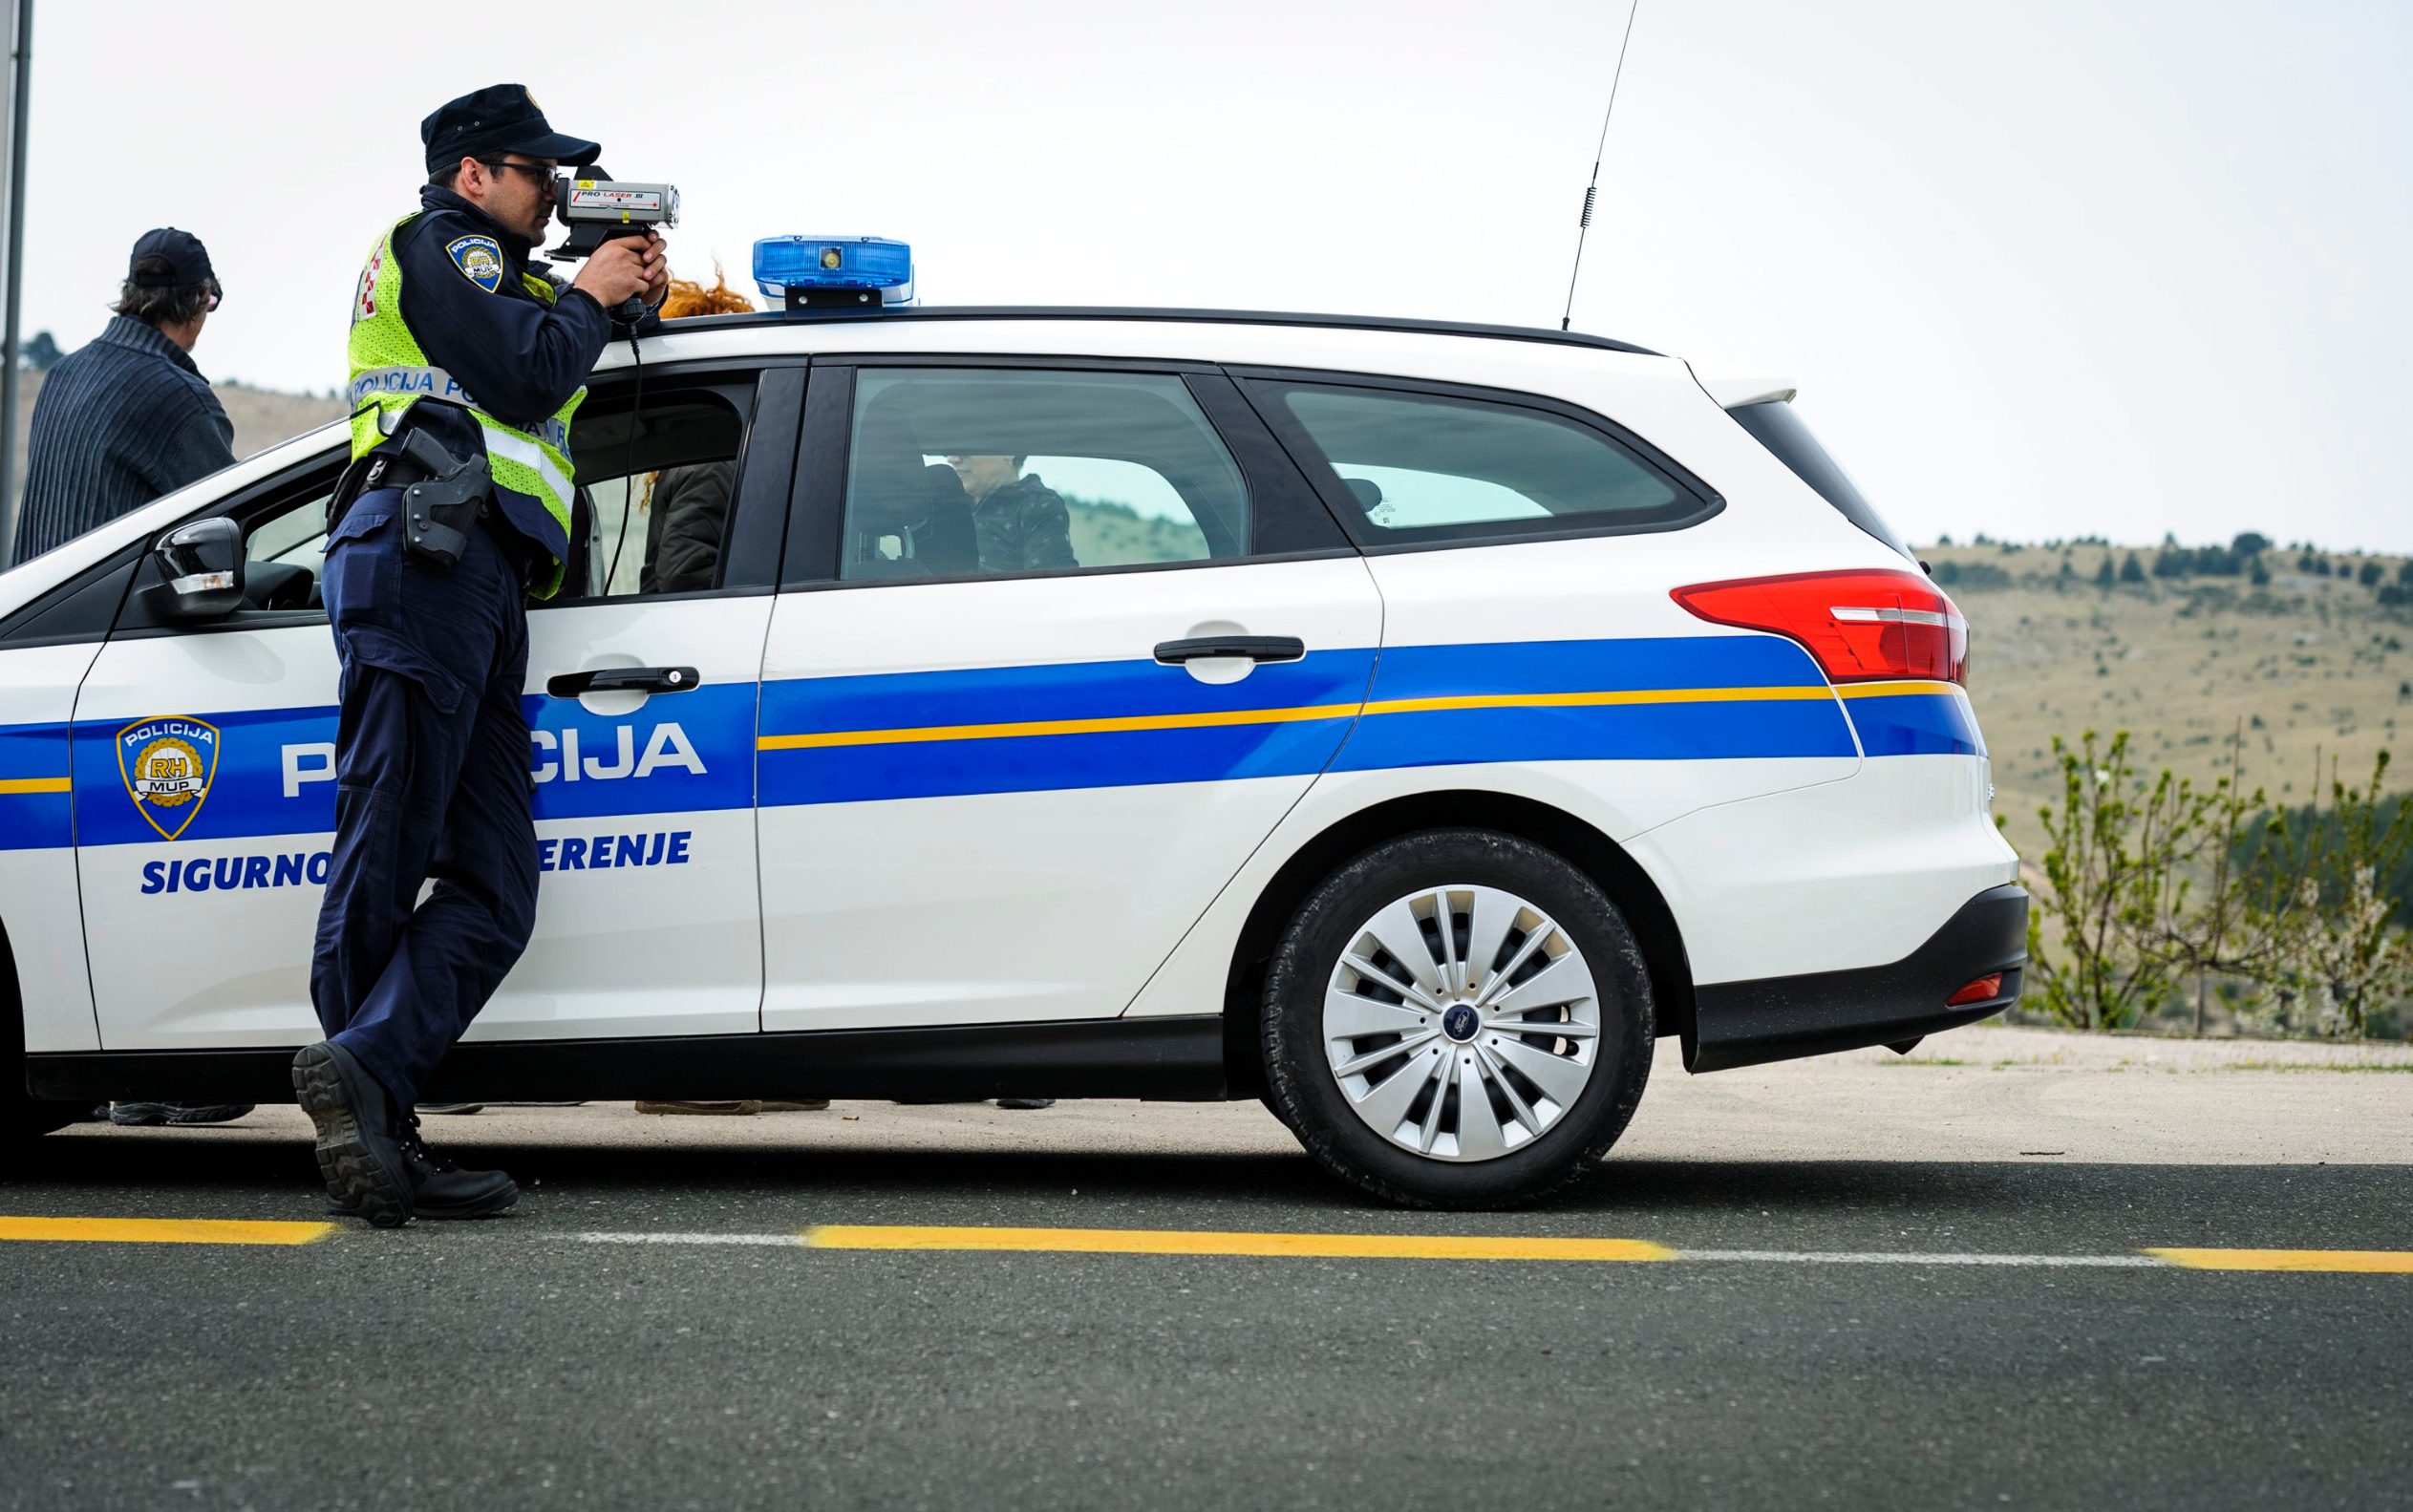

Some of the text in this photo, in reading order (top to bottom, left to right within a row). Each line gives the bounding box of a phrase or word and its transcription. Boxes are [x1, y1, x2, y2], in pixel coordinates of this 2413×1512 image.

[451, 238, 497, 253] POLICIJA
[354, 372, 434, 394] POLICIJA
[124, 723, 213, 748] POLICIJA
[150, 757, 188, 778] RH
[149, 780, 190, 793] MUP
[140, 830, 693, 895] SIGURNO ERENJE
